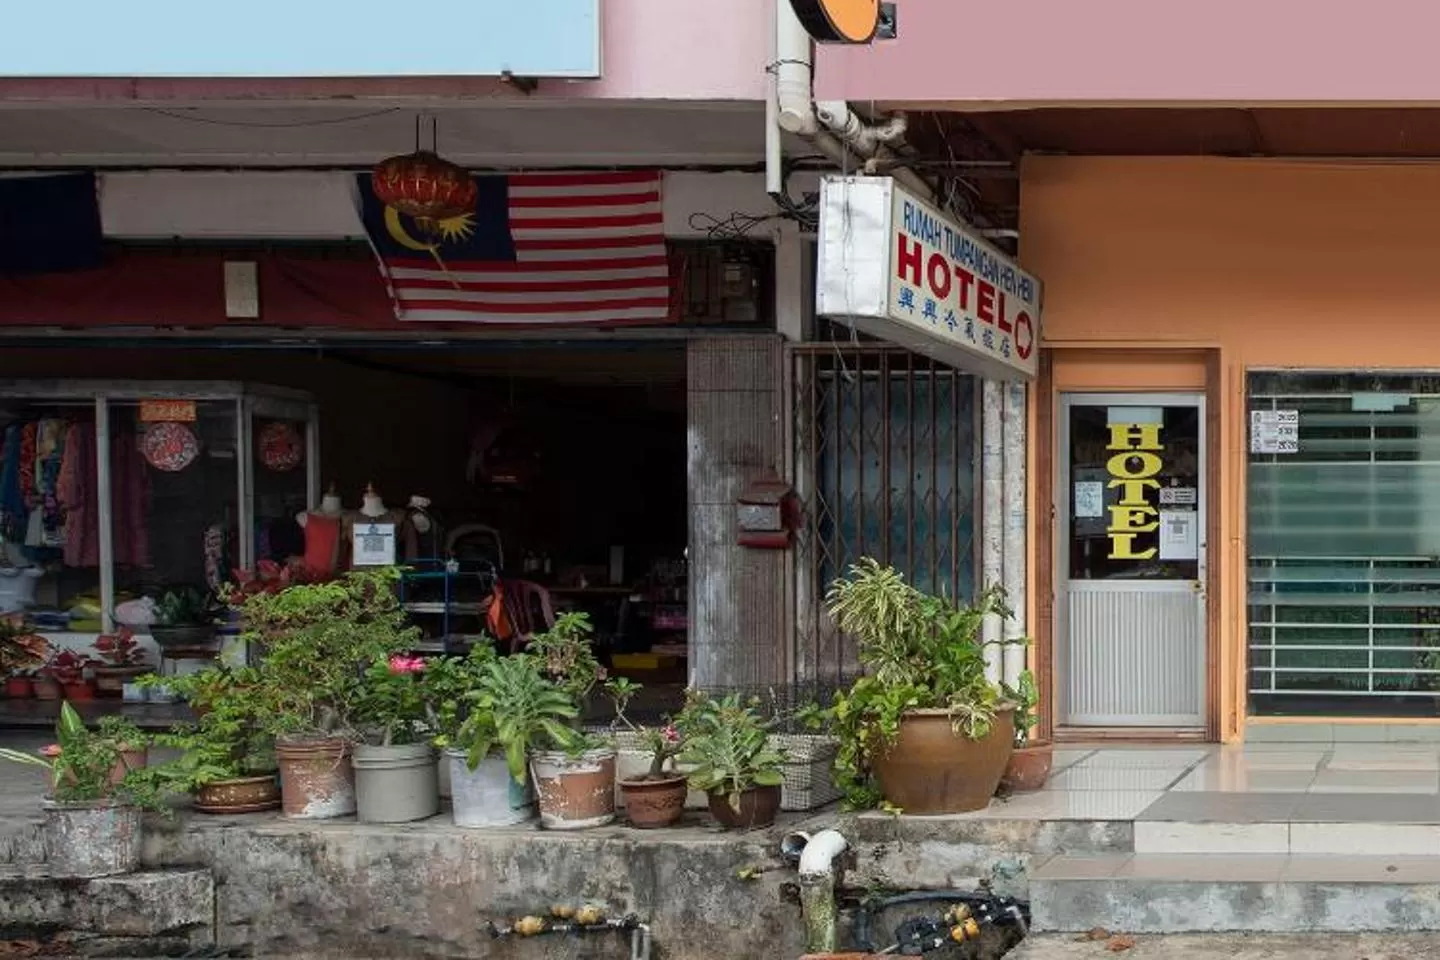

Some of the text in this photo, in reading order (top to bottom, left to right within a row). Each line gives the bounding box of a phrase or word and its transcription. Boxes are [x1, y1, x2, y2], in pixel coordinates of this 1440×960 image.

[897, 231, 1012, 333] HOTEL
[903, 200, 942, 250] RUMAH
[944, 226, 1000, 286] TUMPANGAN
[1106, 423, 1164, 559] HOTEL
